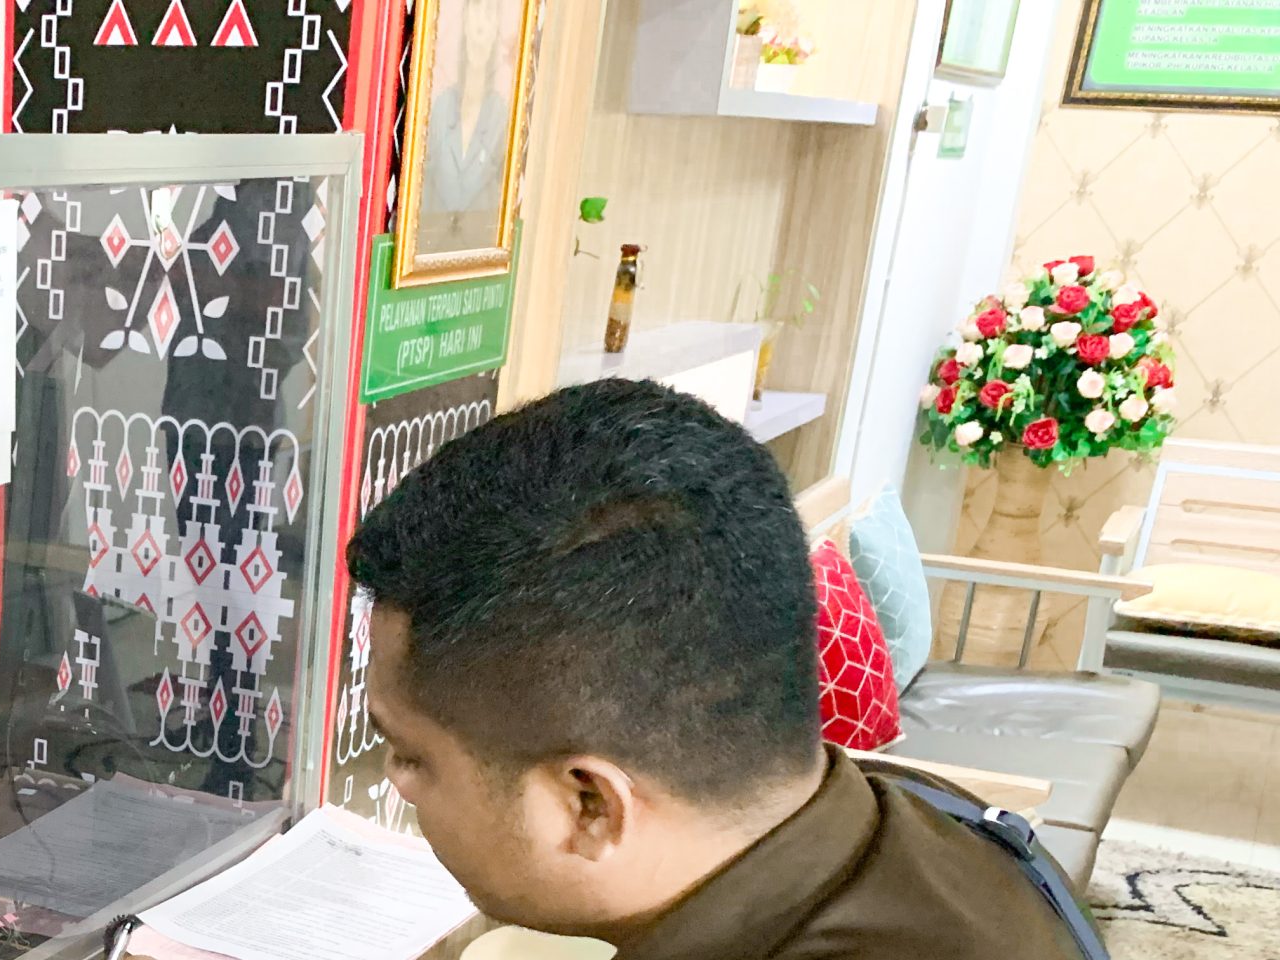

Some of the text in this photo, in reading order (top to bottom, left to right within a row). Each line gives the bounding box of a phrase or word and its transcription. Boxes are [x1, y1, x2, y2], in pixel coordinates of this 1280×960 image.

[379, 283, 506, 334] PELAYANAN TERPADU SATU PINTU
[396, 324, 483, 376] (PTSP) HARI INI
